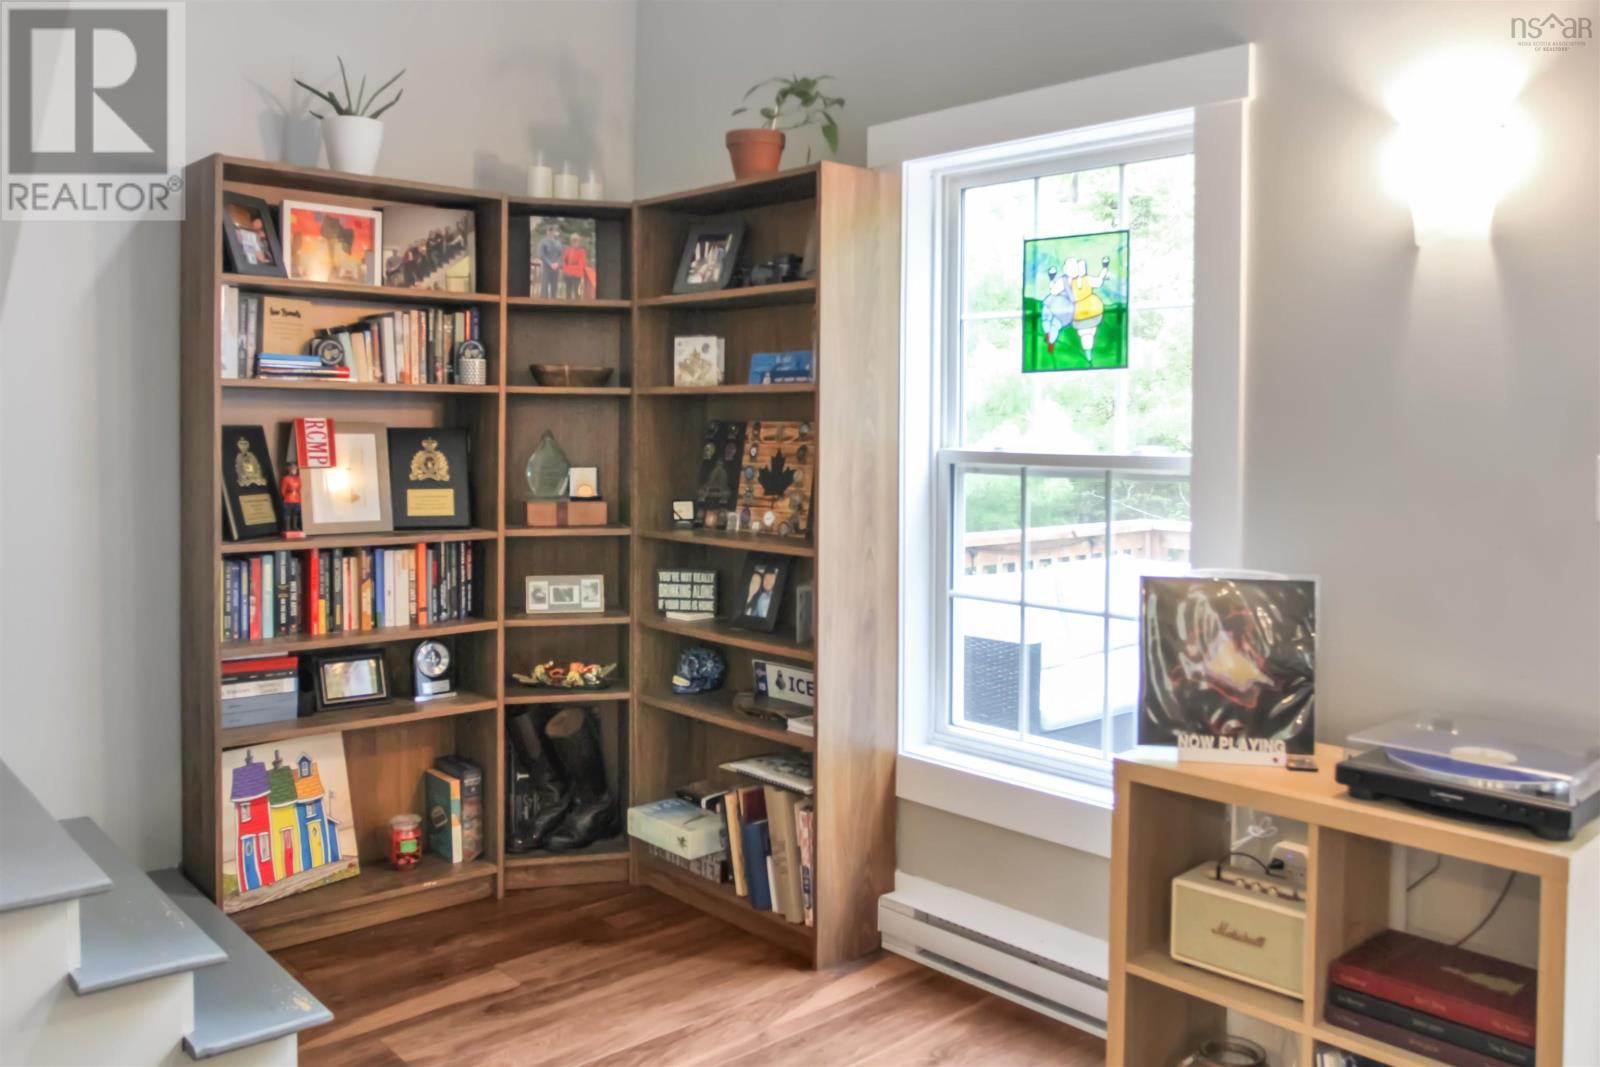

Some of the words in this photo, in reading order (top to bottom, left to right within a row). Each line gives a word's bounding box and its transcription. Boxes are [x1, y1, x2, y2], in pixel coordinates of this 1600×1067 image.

[304, 419, 329, 466] RCMP
[788, 676, 814, 697] ICE
[1178, 733, 1215, 750] NOW
[1219, 735, 1286, 753] PLAYING
